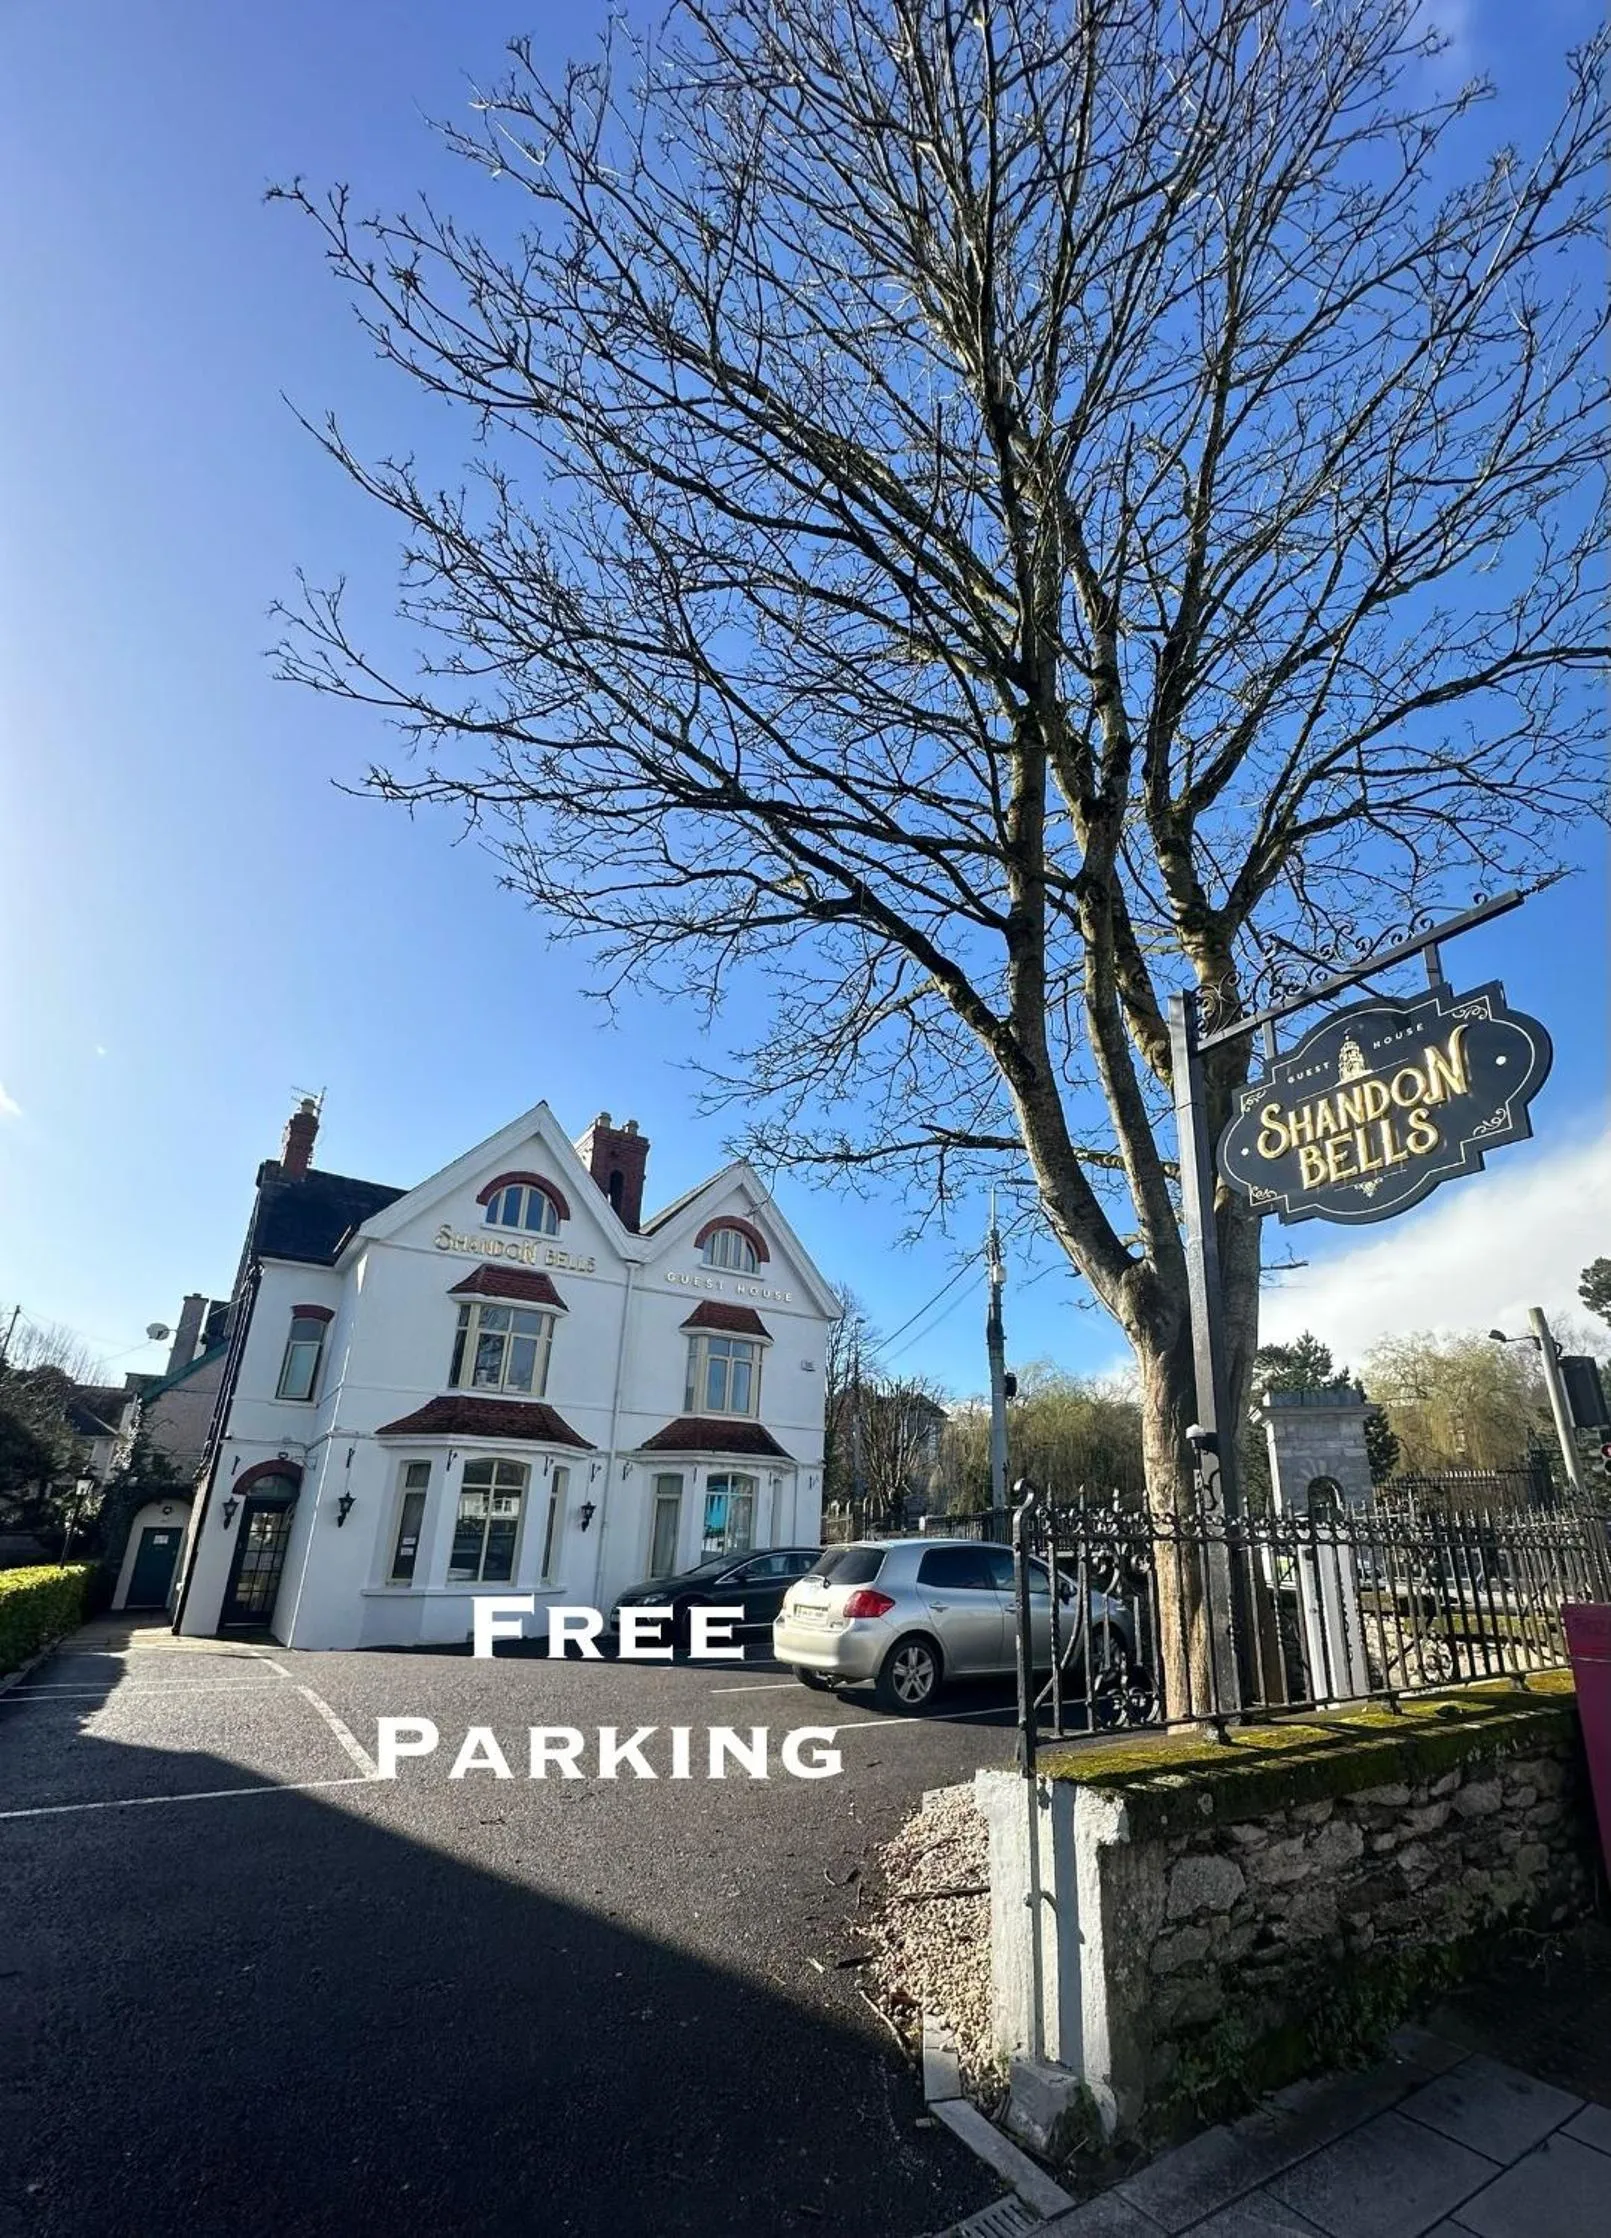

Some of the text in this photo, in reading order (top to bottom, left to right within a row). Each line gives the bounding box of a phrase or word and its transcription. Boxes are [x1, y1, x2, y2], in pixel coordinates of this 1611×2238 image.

[1286, 1022, 1425, 1084] GUEST HOUSE
[1256, 1023, 1471, 1160] SHANDON
[1298, 1107, 1440, 1191] BELLS
[434, 1224, 597, 1274] SHANDON BELLS
[667, 1271, 793, 1302] GUEST HOUSE
